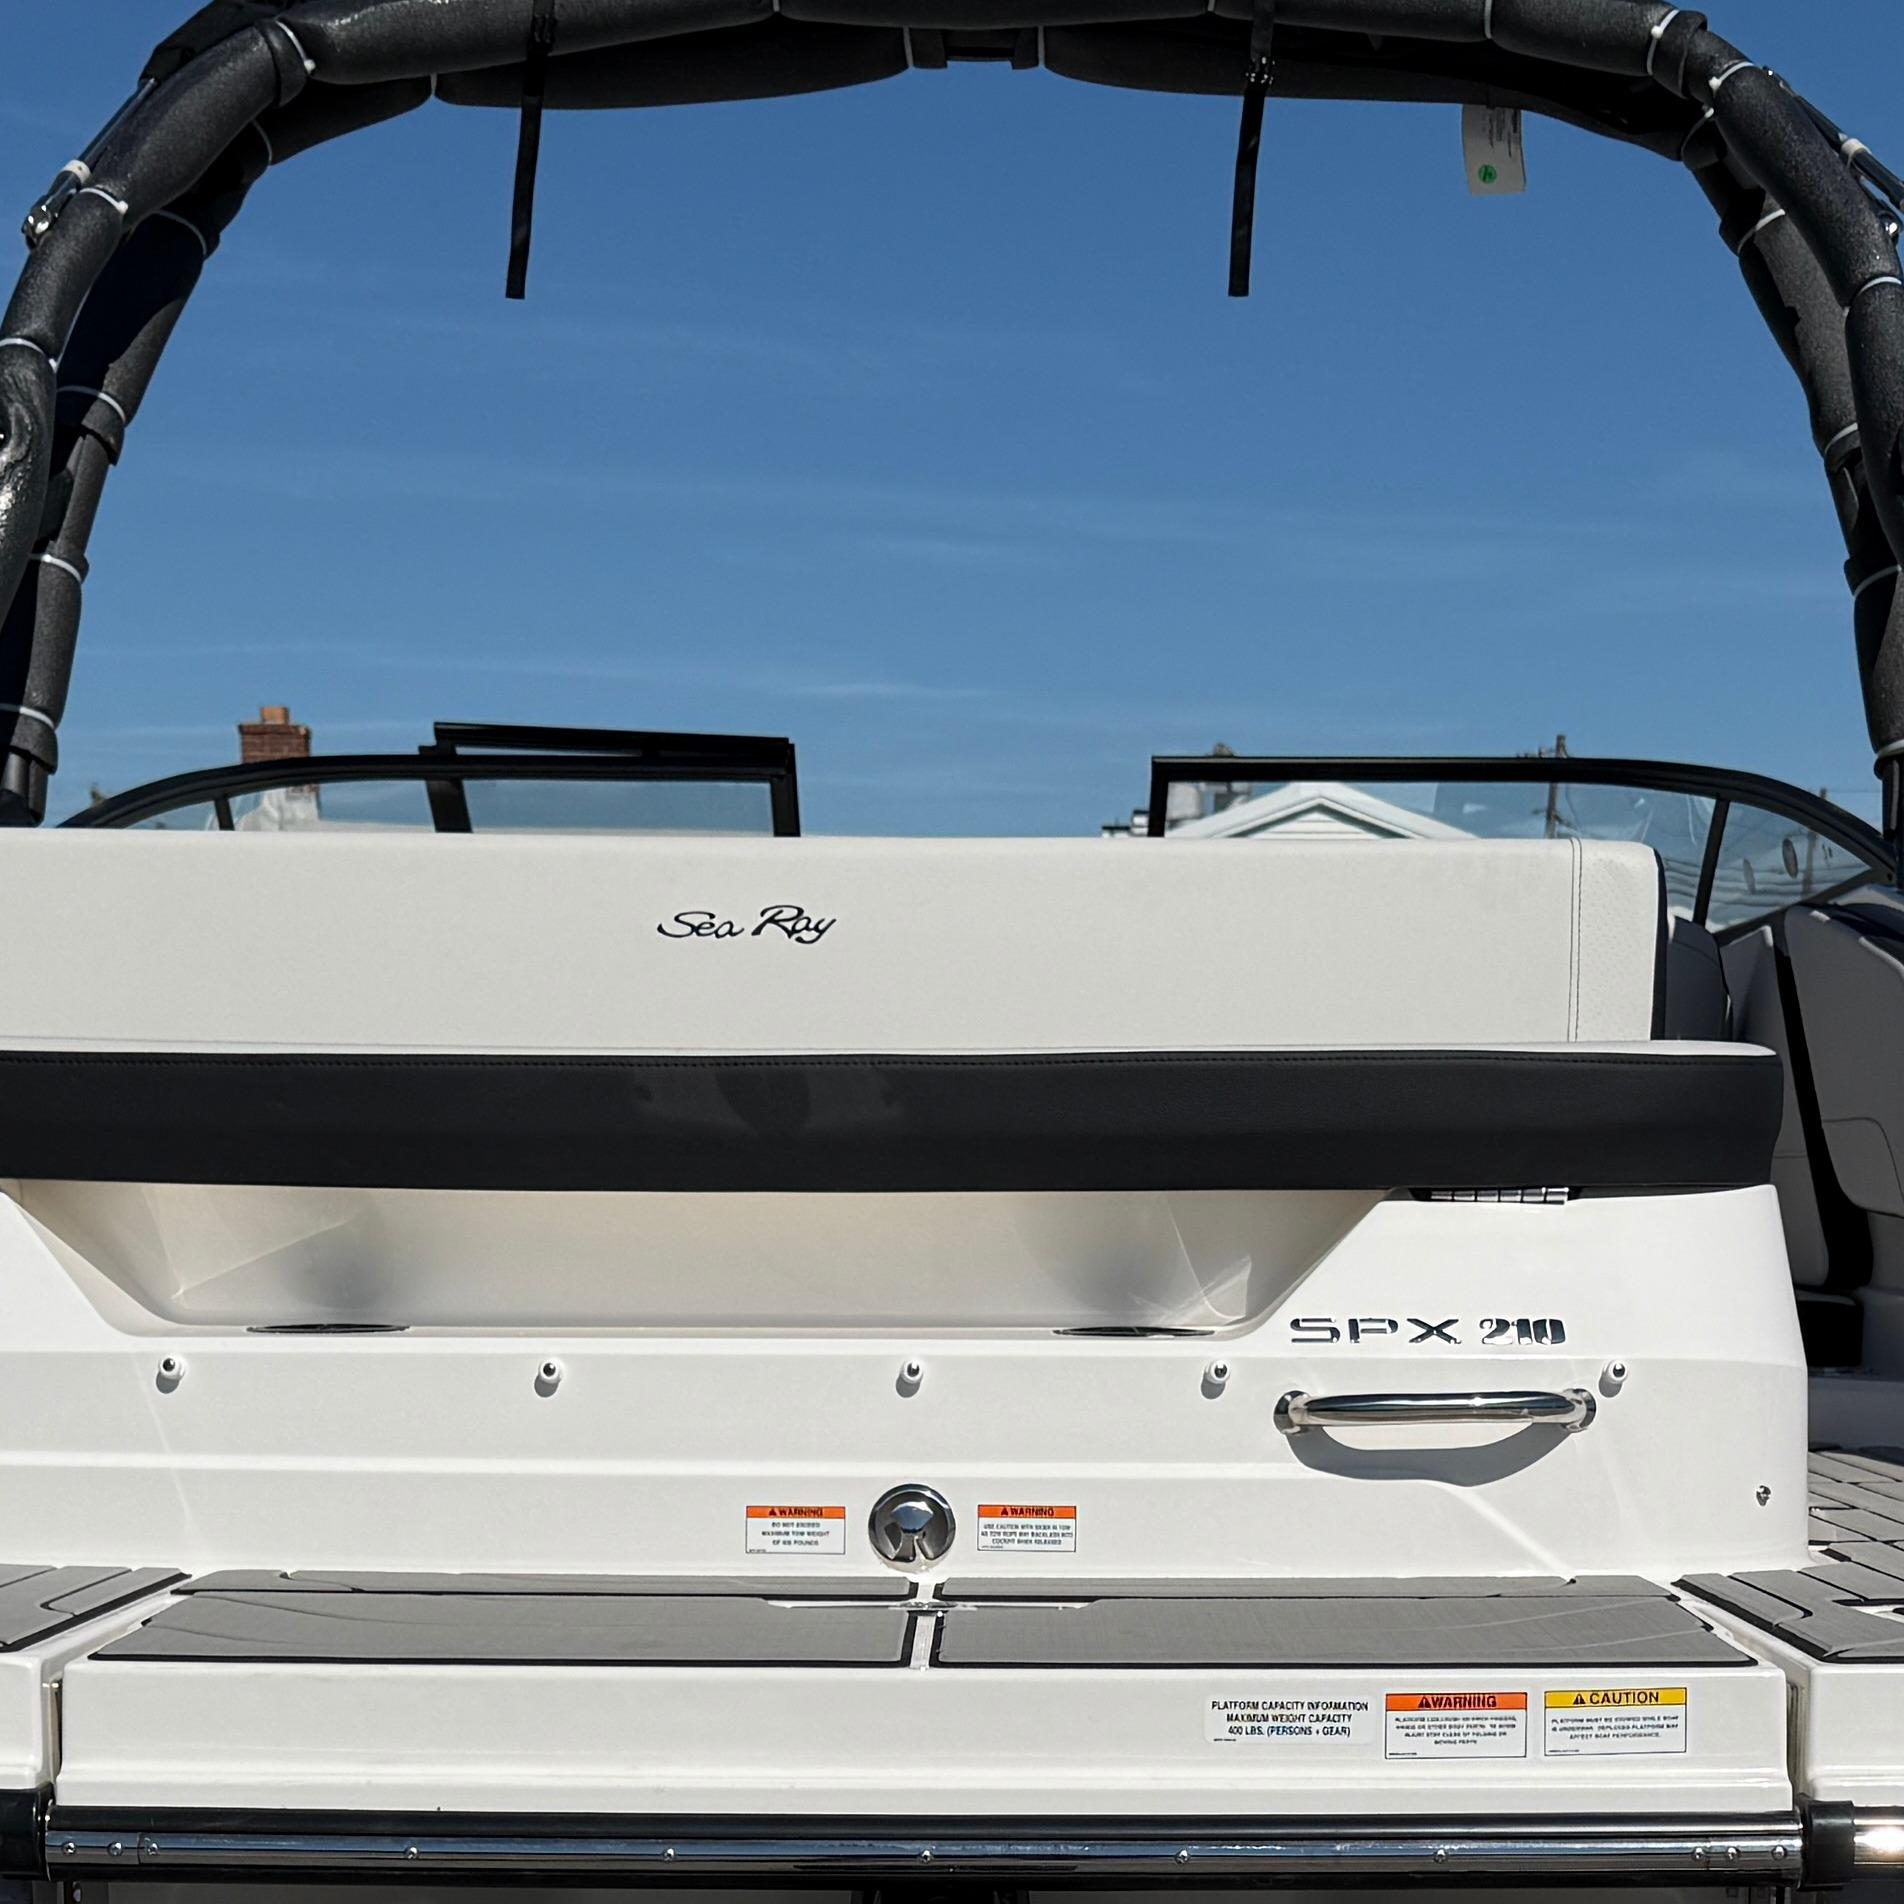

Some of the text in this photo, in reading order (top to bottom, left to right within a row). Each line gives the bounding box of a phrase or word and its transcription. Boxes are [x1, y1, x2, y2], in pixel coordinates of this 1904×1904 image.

[657, 904, 837, 944] Sea Ray
[1289, 1317, 1567, 1345] SPX 210
[1010, 1507, 1055, 1517] WARNING
[1431, 1695, 1497, 1708] WARNING
[1589, 1691, 1659, 1705] CAUTION
[1211, 1701, 1369, 1711] PLATFORM CAPACITY INFORMATION
[1226, 1714, 1352, 1723] MAXIMUM WEIGHT CAPACITY
[1228, 1726, 1243, 1735] 400
